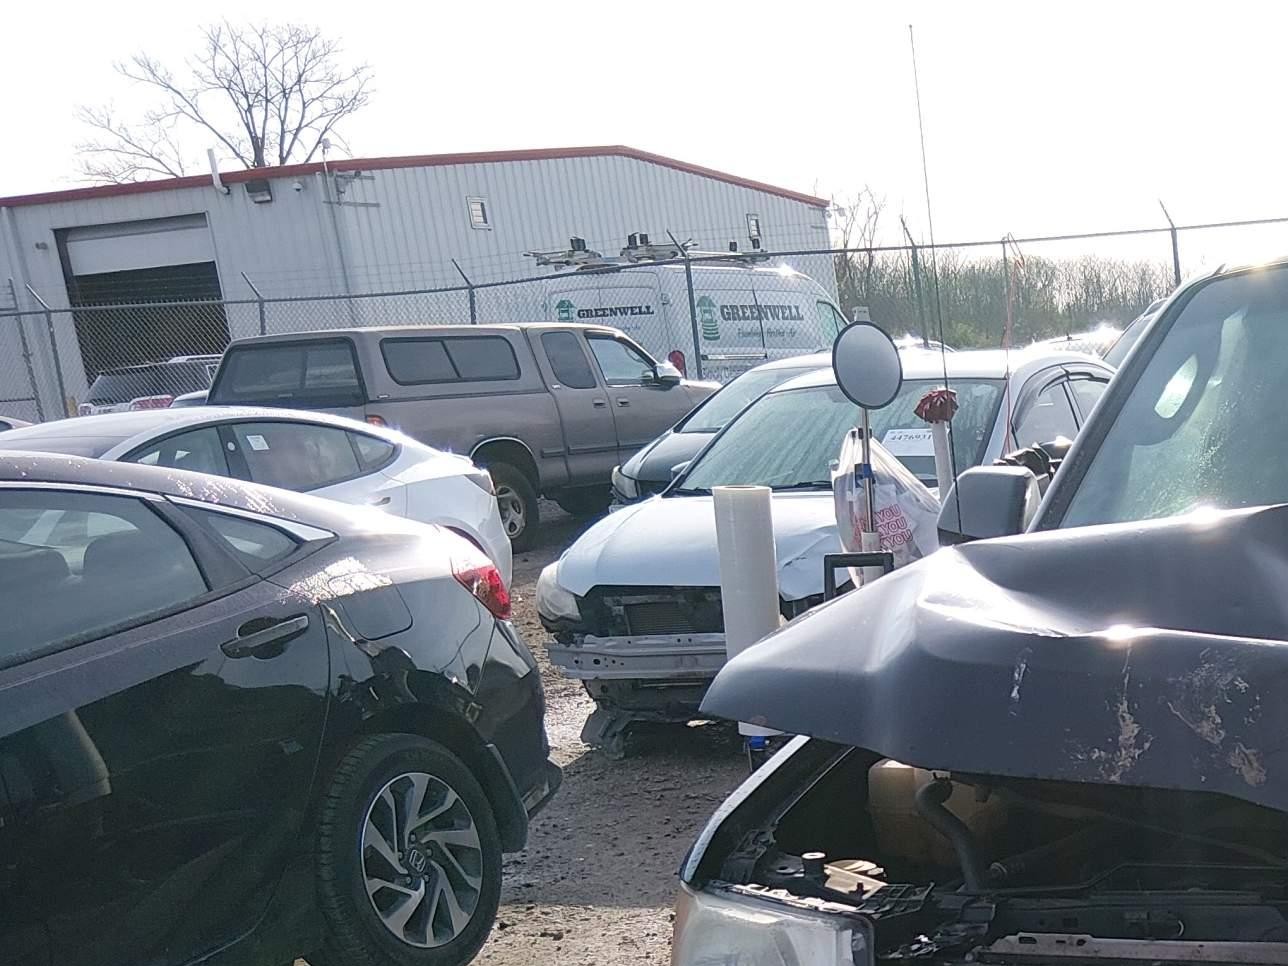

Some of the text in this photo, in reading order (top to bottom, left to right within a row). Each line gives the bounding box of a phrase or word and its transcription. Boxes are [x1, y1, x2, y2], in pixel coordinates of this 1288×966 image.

[577, 305, 655, 319] GREENWELL
[720, 304, 804, 321] GREENWELL
[877, 504, 901, 522] YOU
[881, 516, 908, 536] YOU
[886, 529, 914, 547] YOU
